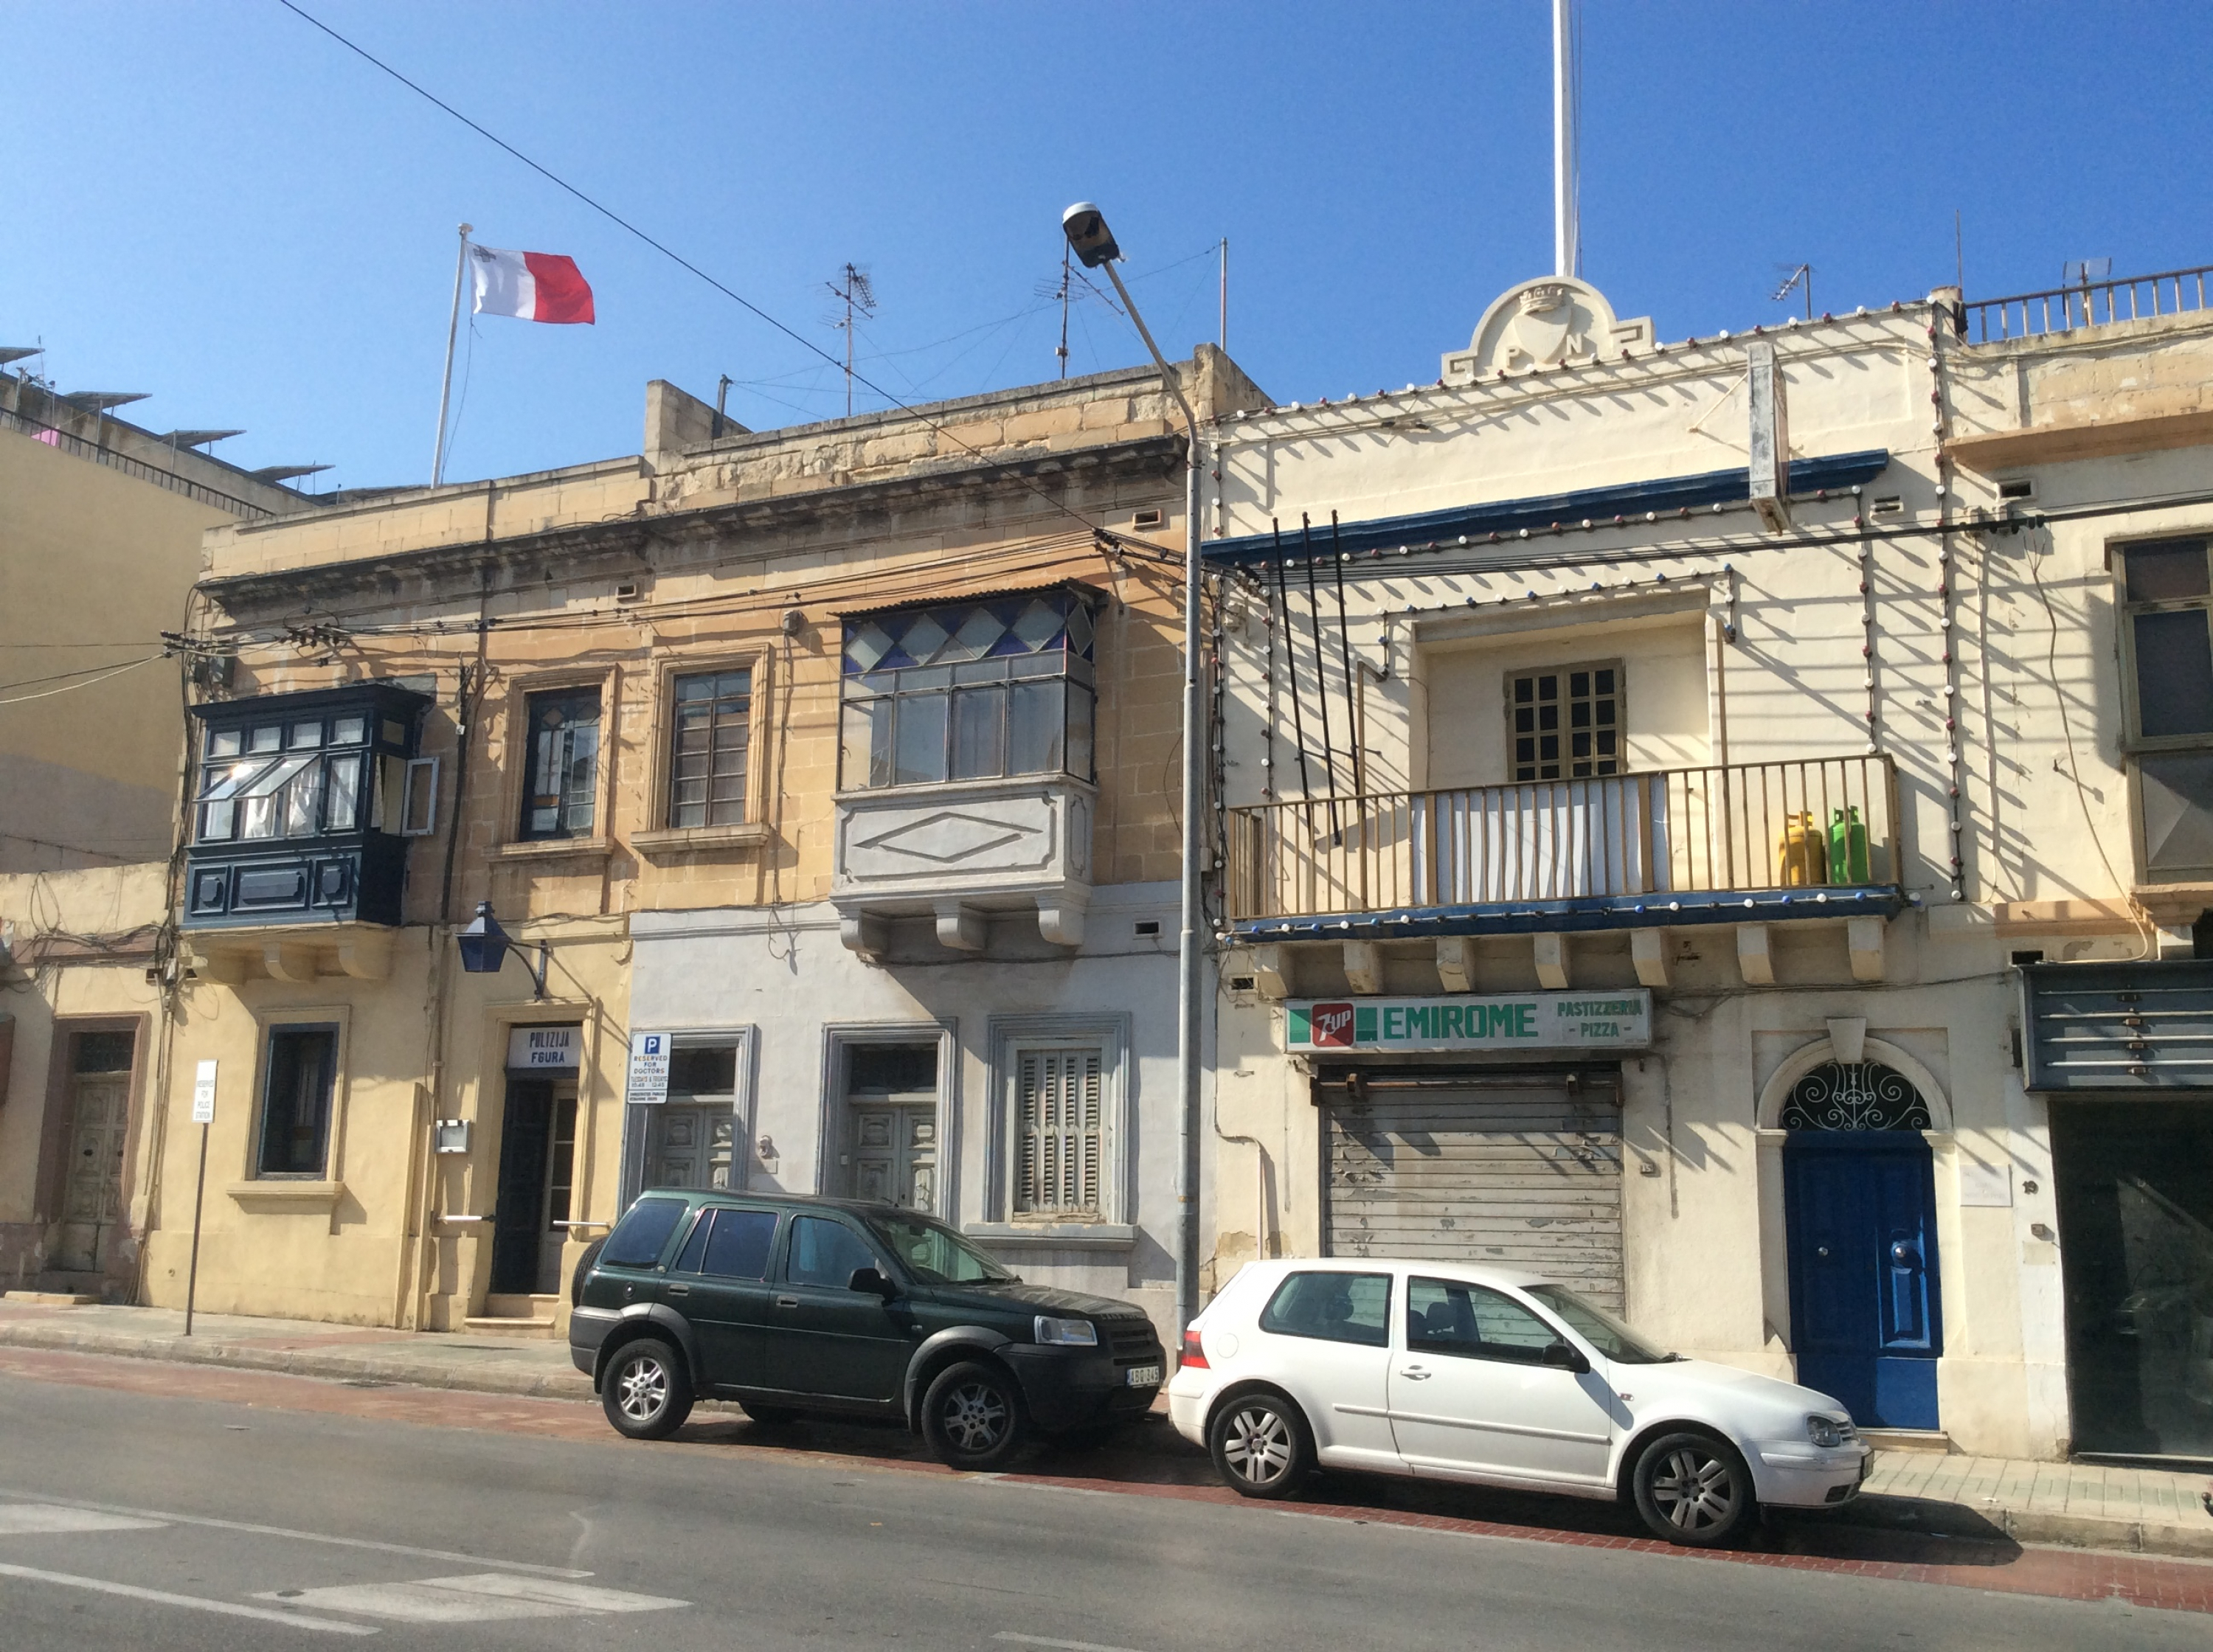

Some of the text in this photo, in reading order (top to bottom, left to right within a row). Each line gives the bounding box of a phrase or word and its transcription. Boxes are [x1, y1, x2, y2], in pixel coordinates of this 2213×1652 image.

[1506, 332, 1582, 369] P N
[1557, 1000, 1643, 1016] PASTIZZERIA
[1316, 1010, 1351, 1041] 7UP
[1383, 1004, 1539, 1040] EMIROME
[1580, 1022, 1619, 1038] PIZZA
[530, 1032, 569, 1048] PULIZIJA
[647, 1038, 657, 1053] P
[531, 1052, 565, 1063] FGURA
